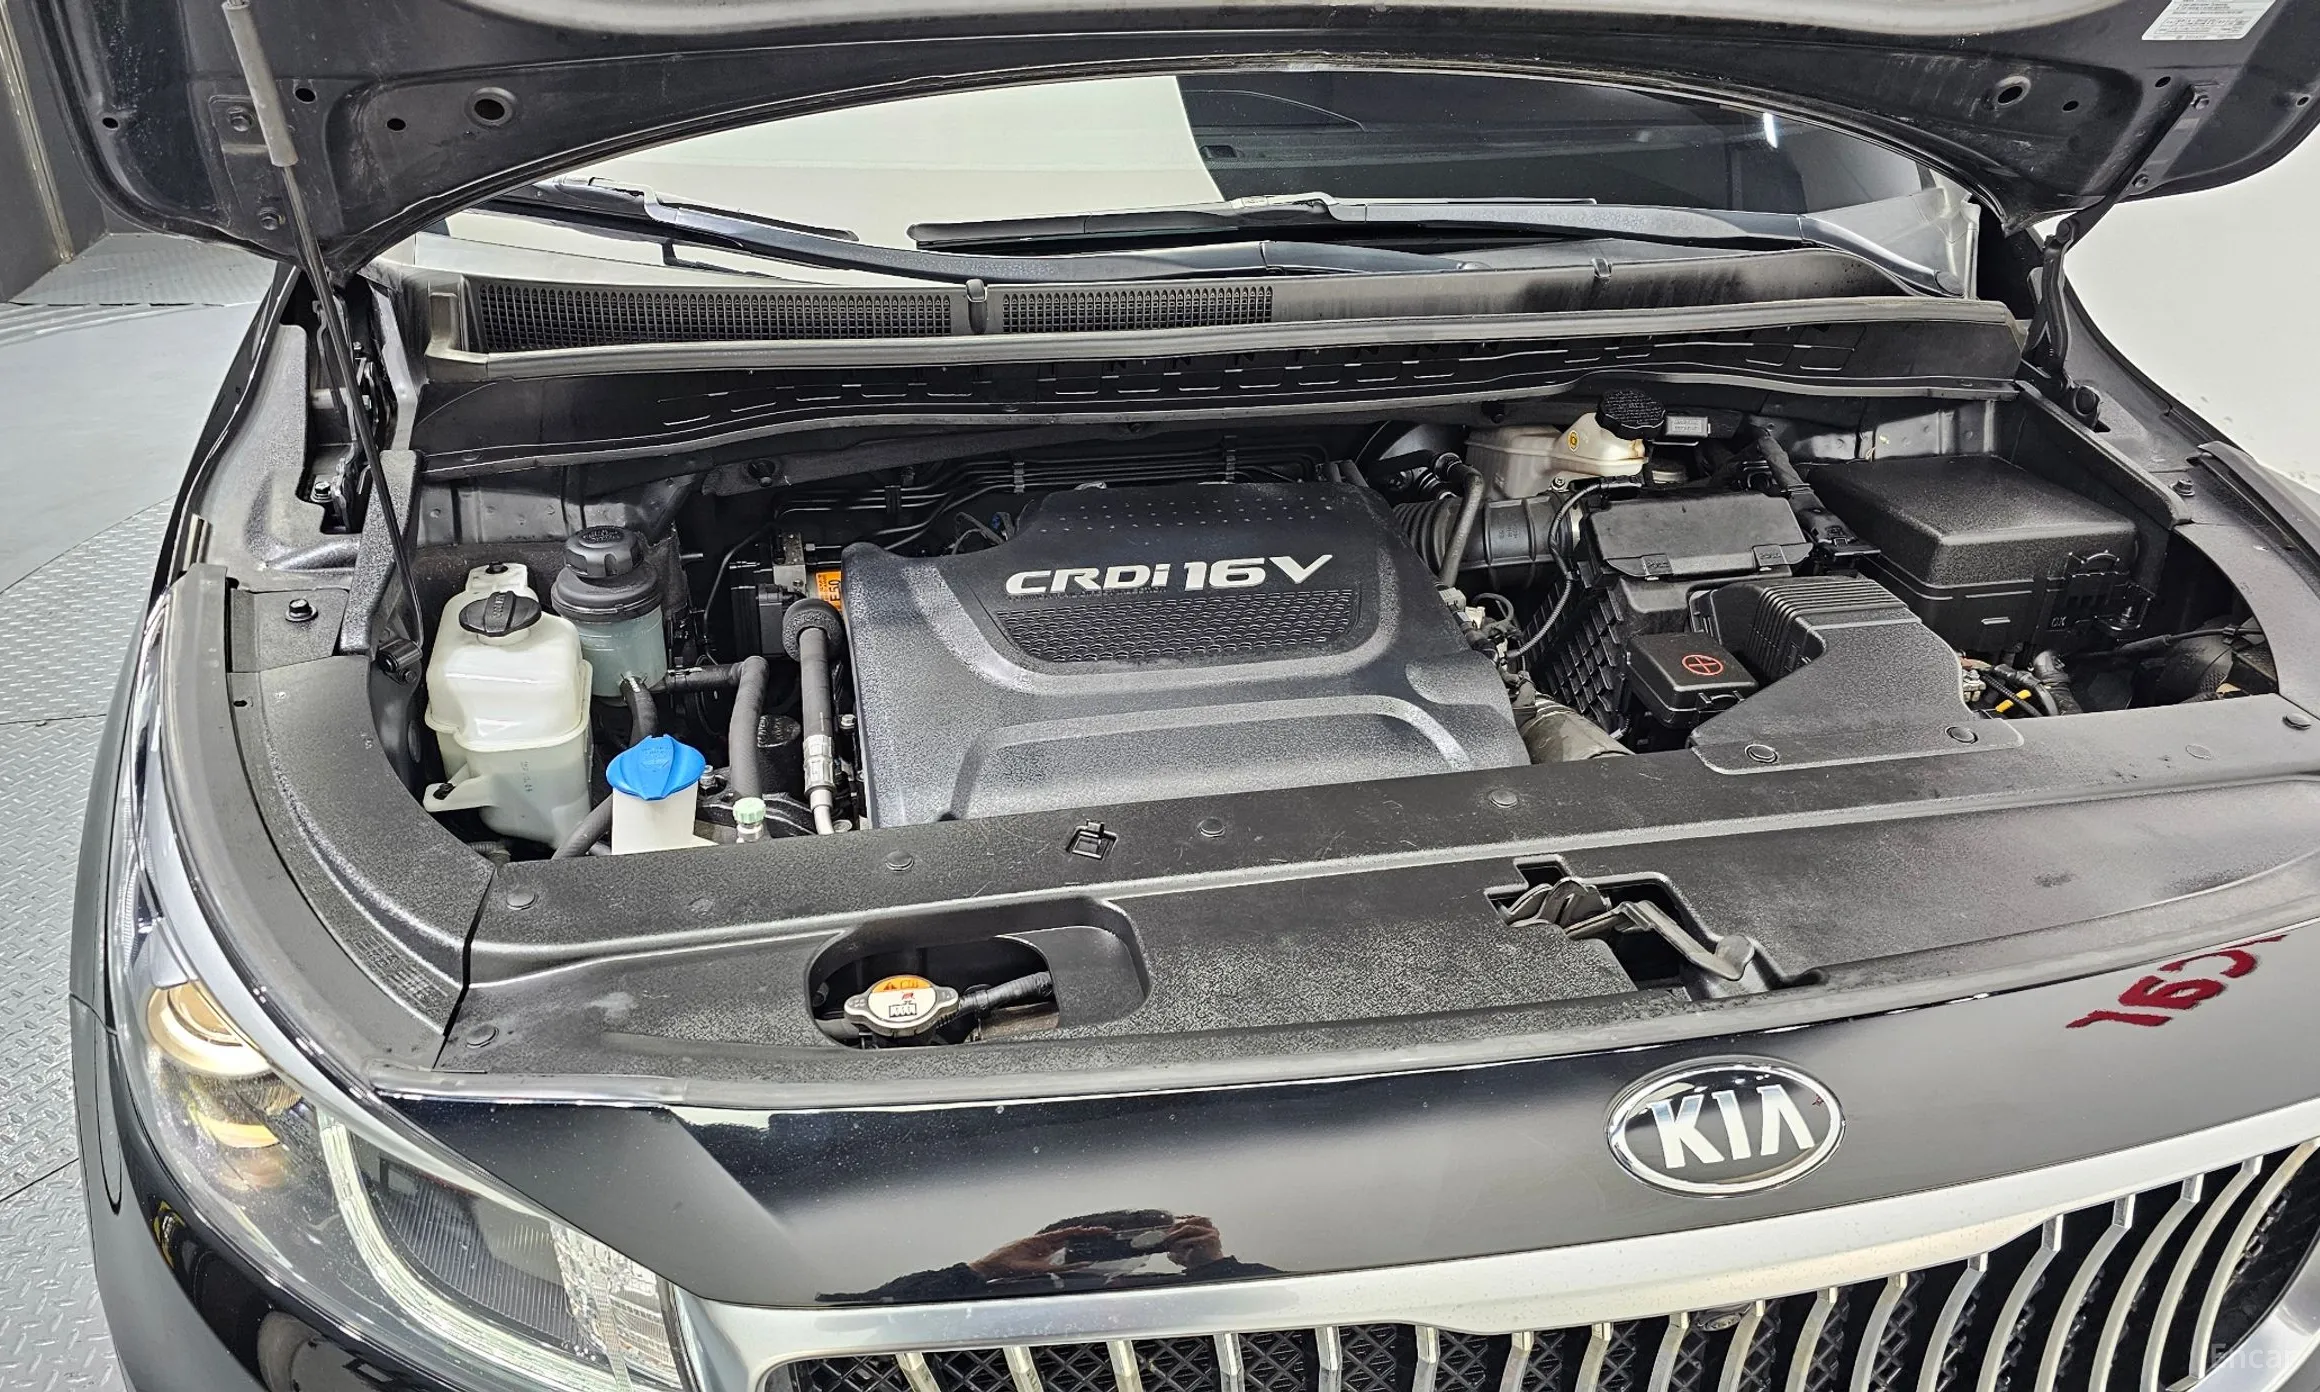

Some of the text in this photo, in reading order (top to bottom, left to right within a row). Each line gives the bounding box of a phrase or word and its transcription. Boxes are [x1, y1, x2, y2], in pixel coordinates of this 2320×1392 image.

[1005, 554, 1333, 596] CRDi 16V
[1647, 1083, 1816, 1169] KIA
